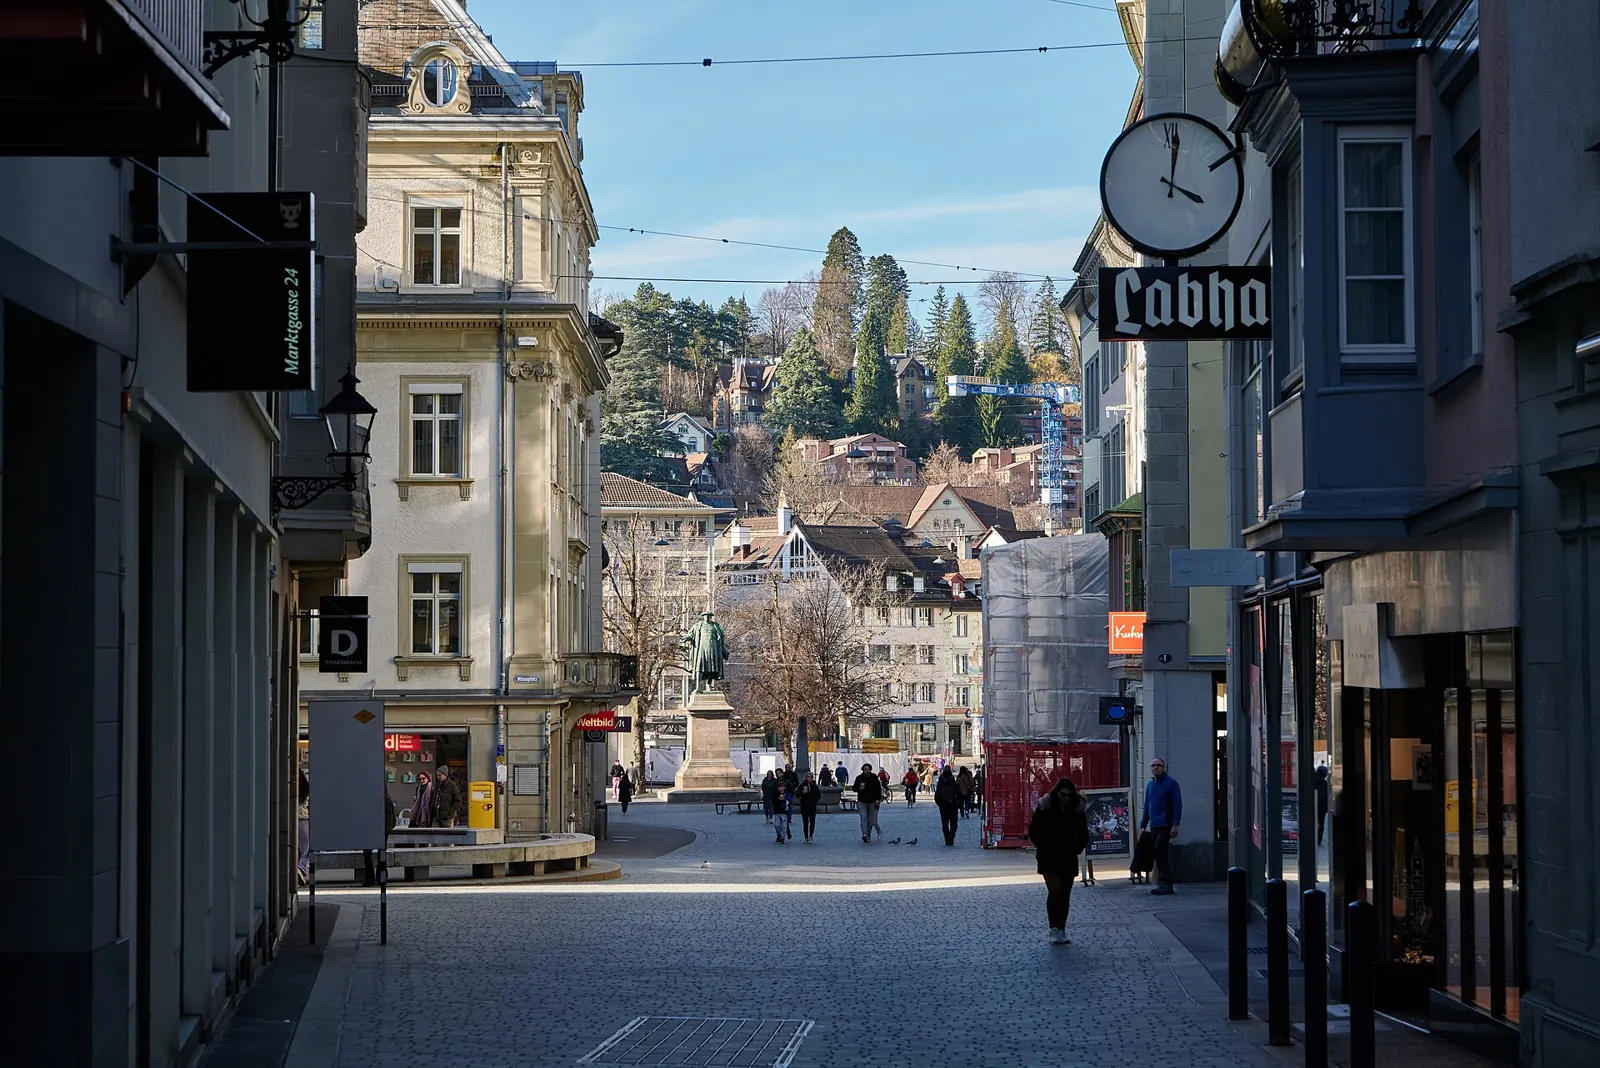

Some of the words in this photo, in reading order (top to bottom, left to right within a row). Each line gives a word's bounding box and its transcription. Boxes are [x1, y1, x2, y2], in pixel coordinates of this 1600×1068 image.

[284, 267, 299, 287] 24
[1115, 268, 1270, 335] Labha
[284, 289, 303, 376] Marktgasse
[1174, 558, 1252, 576] ONLY
[331, 629, 358, 656] D
[576, 718, 613, 727] Weltbild
